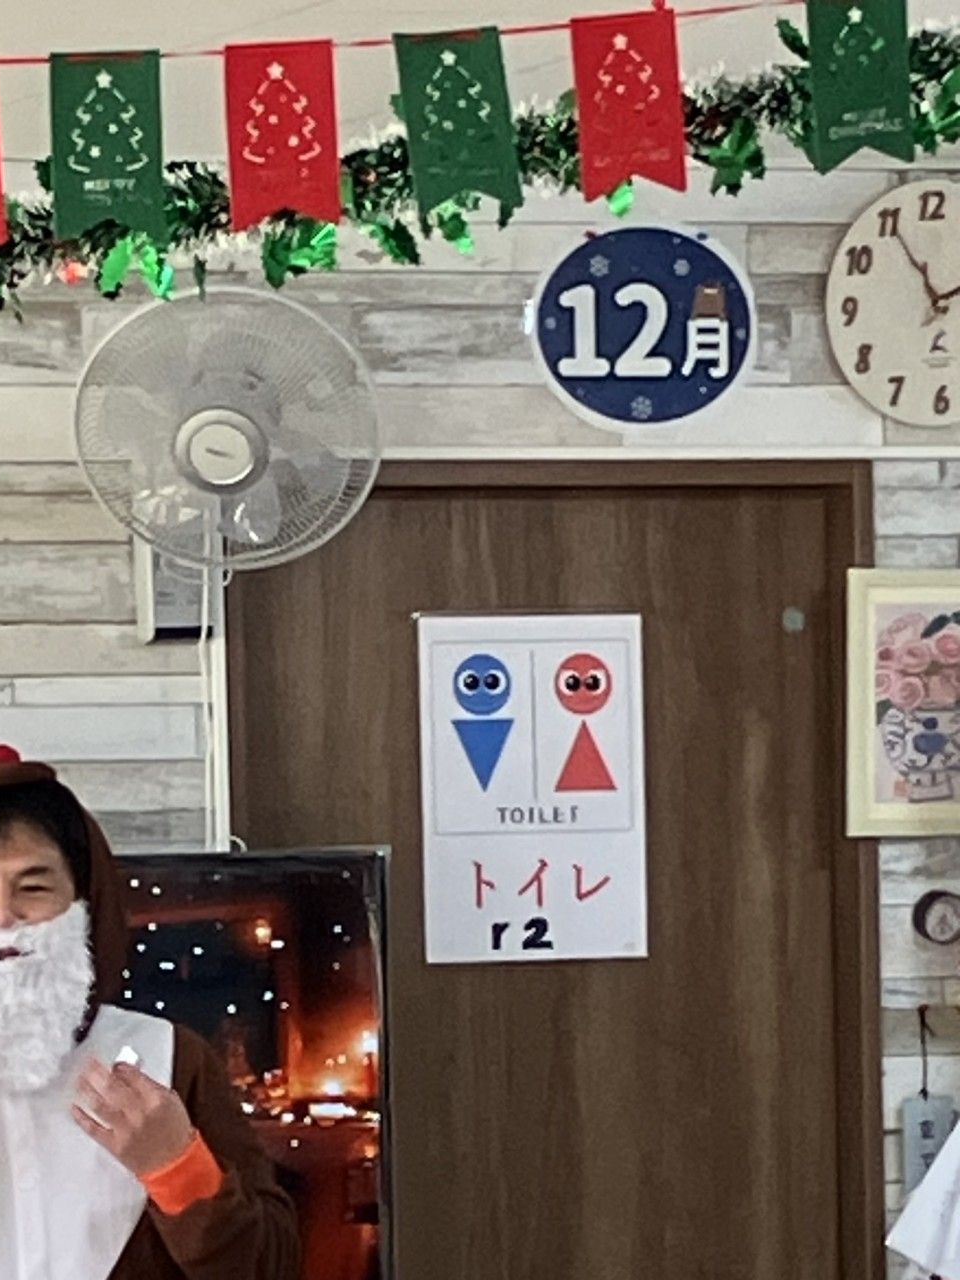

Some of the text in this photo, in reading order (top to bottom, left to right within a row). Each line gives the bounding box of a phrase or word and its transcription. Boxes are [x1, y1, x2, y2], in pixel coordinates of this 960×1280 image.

[918, 190, 945, 221] 12
[877, 207, 901, 237] 11
[845, 245, 873, 276] 10
[841, 296, 858, 327] 9
[558, 282, 730, 379] 12月
[854, 343, 873, 374] 8
[887, 376, 905, 407] 7
[933, 385, 950, 415] 6
[496, 806, 579, 824] TOILET
[472, 858, 611, 909] トイレ
